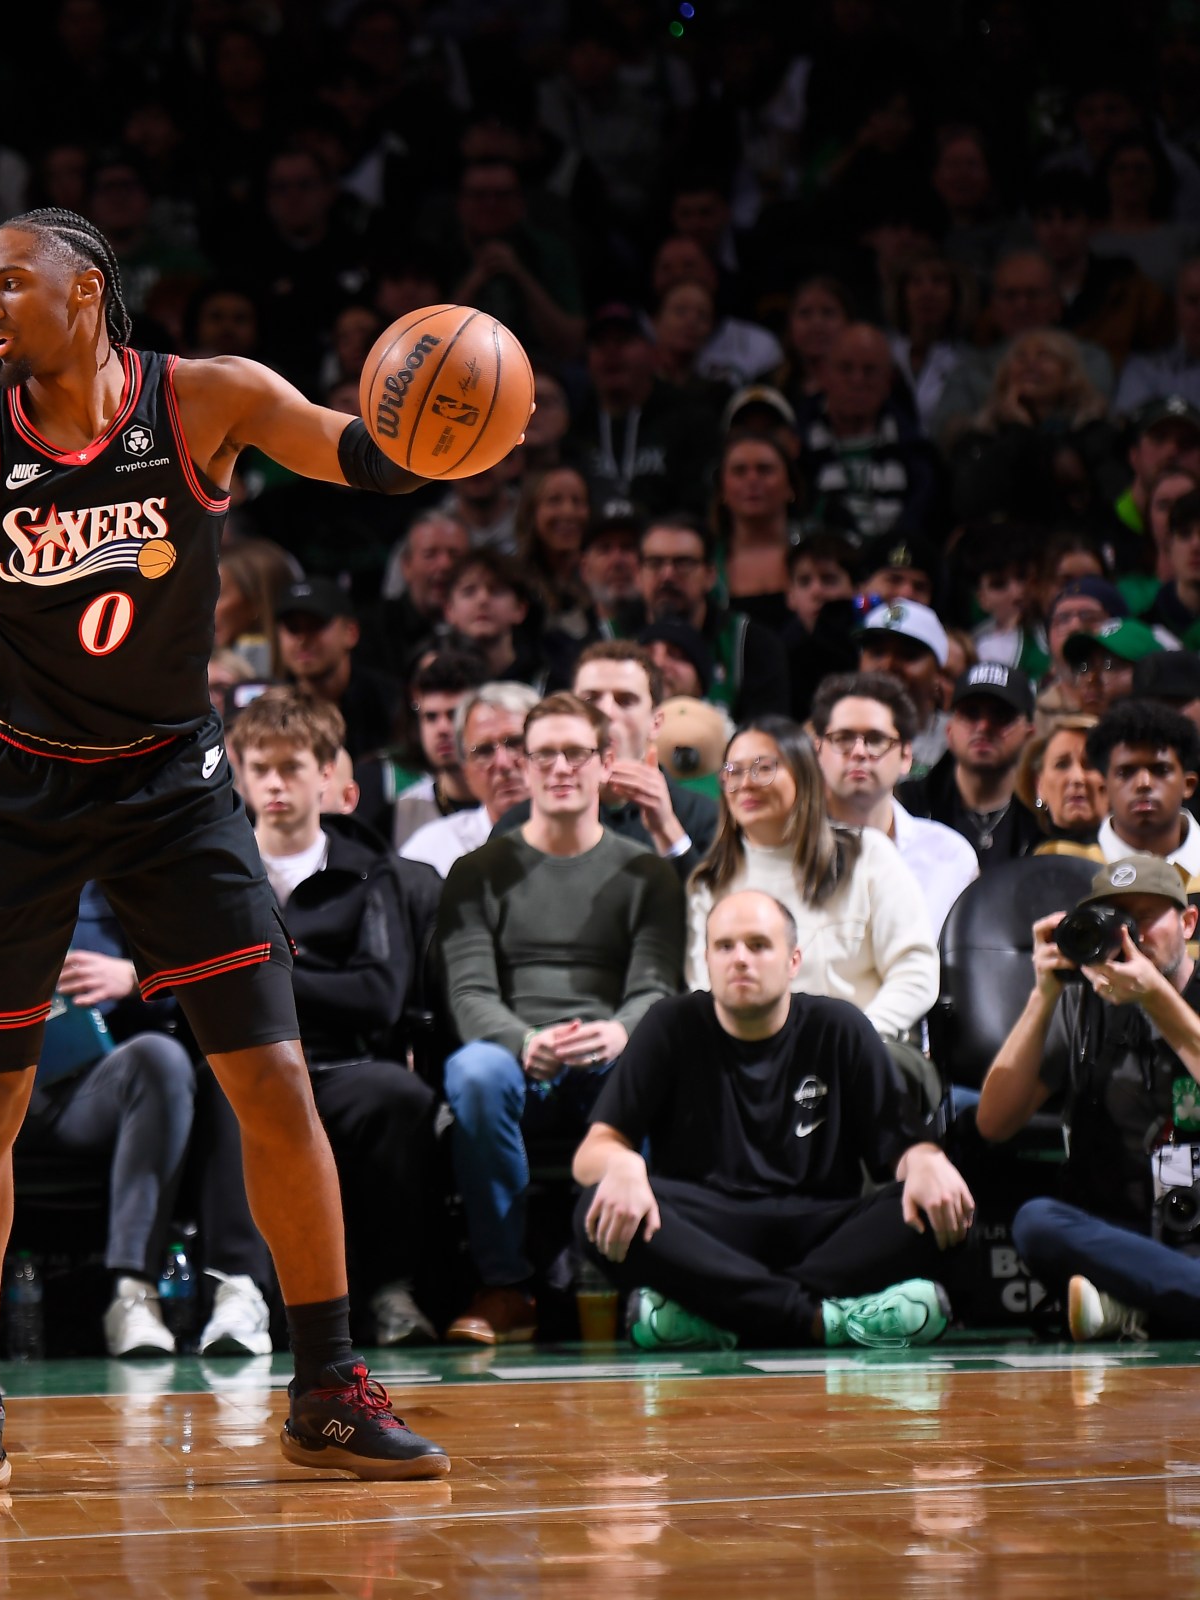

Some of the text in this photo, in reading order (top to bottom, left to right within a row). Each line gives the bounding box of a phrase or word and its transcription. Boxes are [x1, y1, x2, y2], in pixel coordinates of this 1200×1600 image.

[377, 333, 442, 439] Wilson
[11, 463, 41, 480] NIKE
[115, 456, 170, 473] crypto.com
[1, 497, 169, 576] SIXERS
[78, 591, 135, 656] 0
